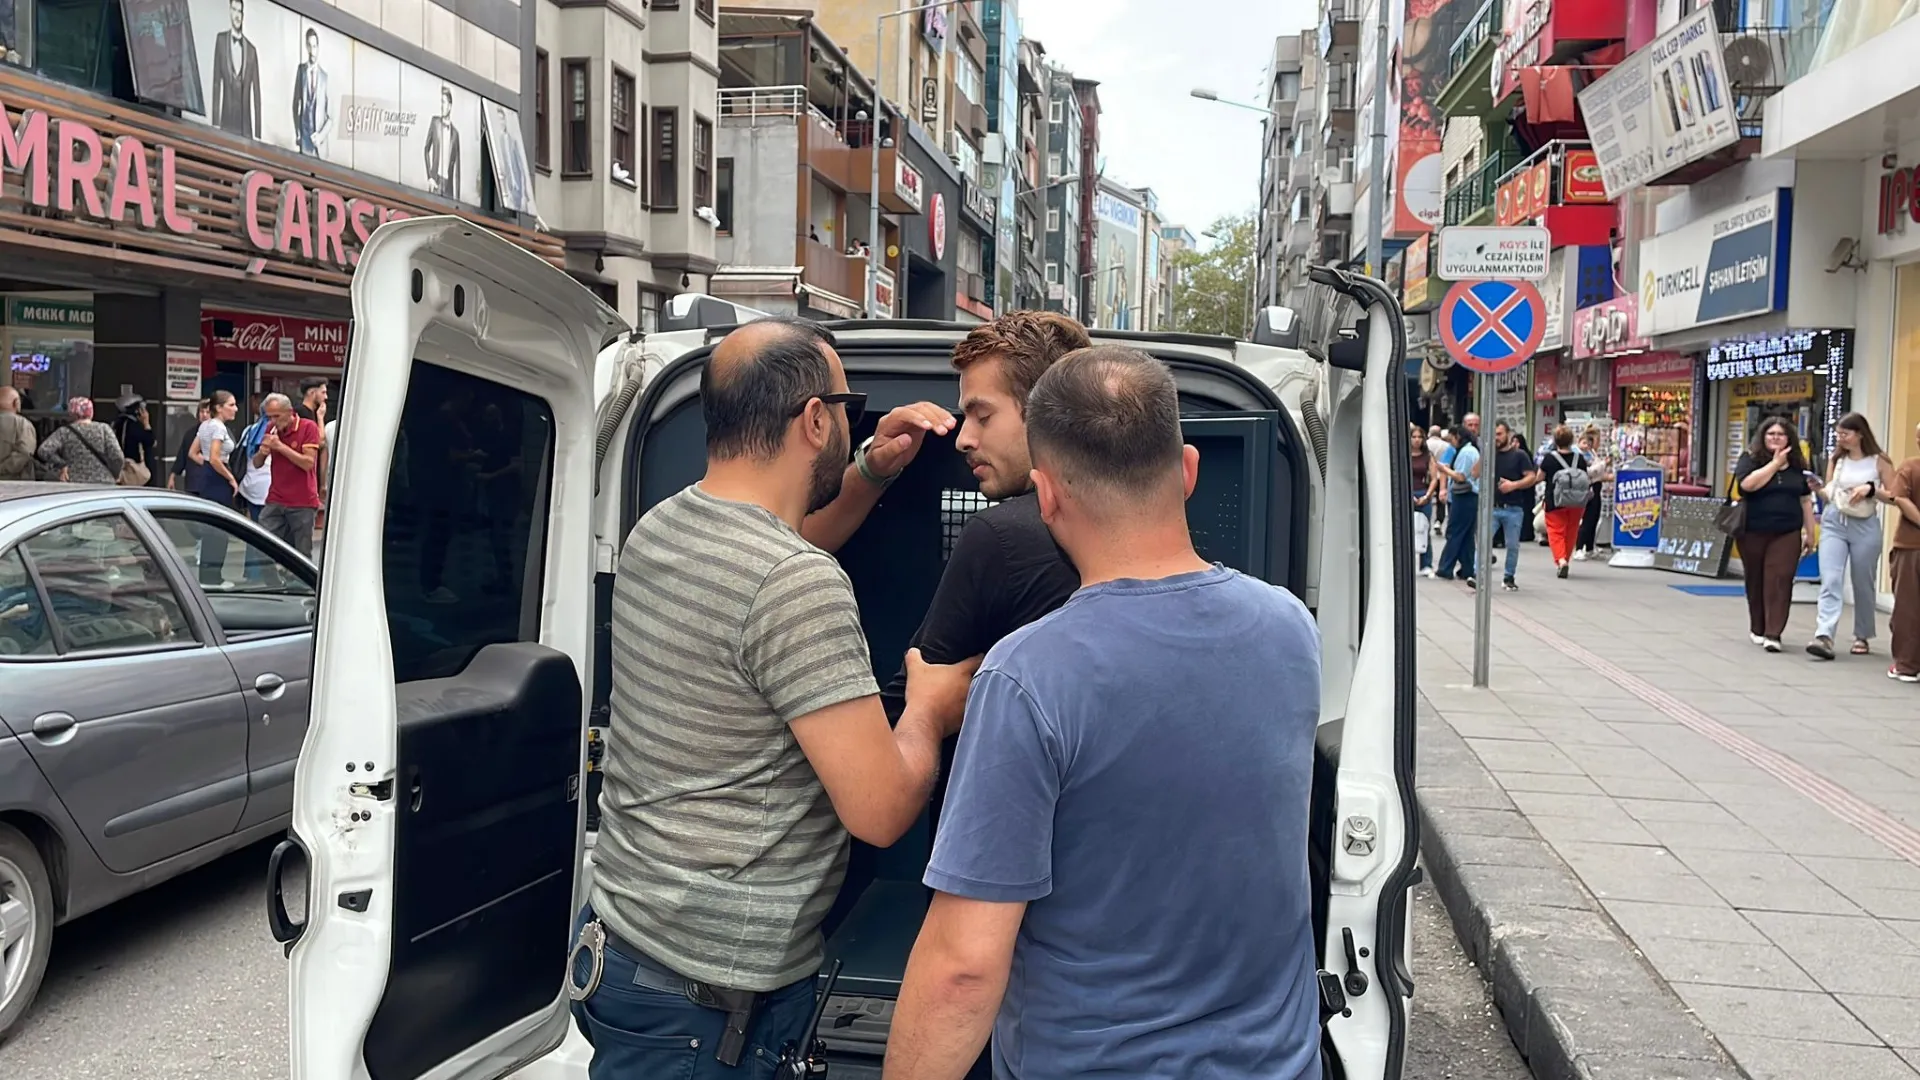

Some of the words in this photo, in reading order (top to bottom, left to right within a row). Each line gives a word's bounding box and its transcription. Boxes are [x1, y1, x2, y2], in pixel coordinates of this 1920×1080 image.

[1499, 240, 1528, 250] KGYS
[1530, 239, 1545, 250] İLE
[1484, 252, 1513, 262] CEZAİ
[1515, 251, 1544, 264] İŞLEM
[1446, 263, 1544, 274] UYGULANMAKTADIR
[1656, 265, 1701, 300] TURKCELL
[1709, 266, 1734, 295] ŞAHAN
[1734, 254, 1768, 285] İLETİŞİM
[23, 306, 65, 321] MEKKE
[304, 323, 343, 342] MİNİ
[297, 341, 330, 353] CEVAT
[1618, 477, 1657, 493] SAHAN
